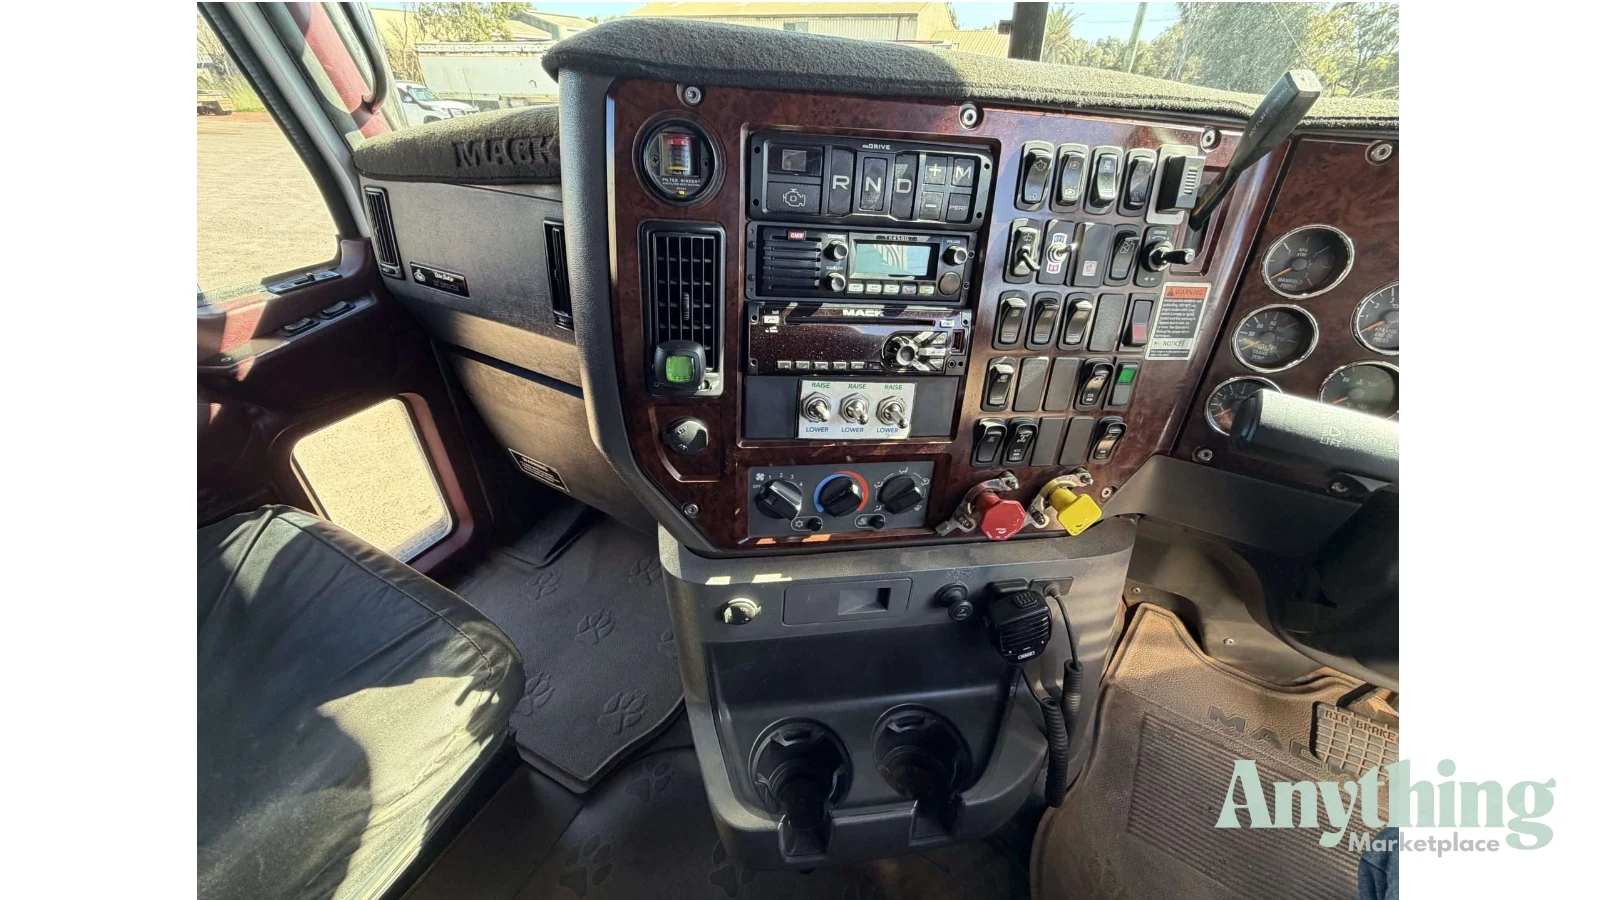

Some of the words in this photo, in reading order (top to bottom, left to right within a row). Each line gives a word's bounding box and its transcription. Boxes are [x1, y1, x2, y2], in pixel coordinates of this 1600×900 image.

[955, 165, 972, 179] M
[832, 174, 850, 190] R
[865, 176, 882, 192] N
[896, 178, 912, 194] D
[842, 309, 885, 317] MACK
[1325, 710, 1350, 724] AIR
[1355, 720, 1397, 741] BRAKE
